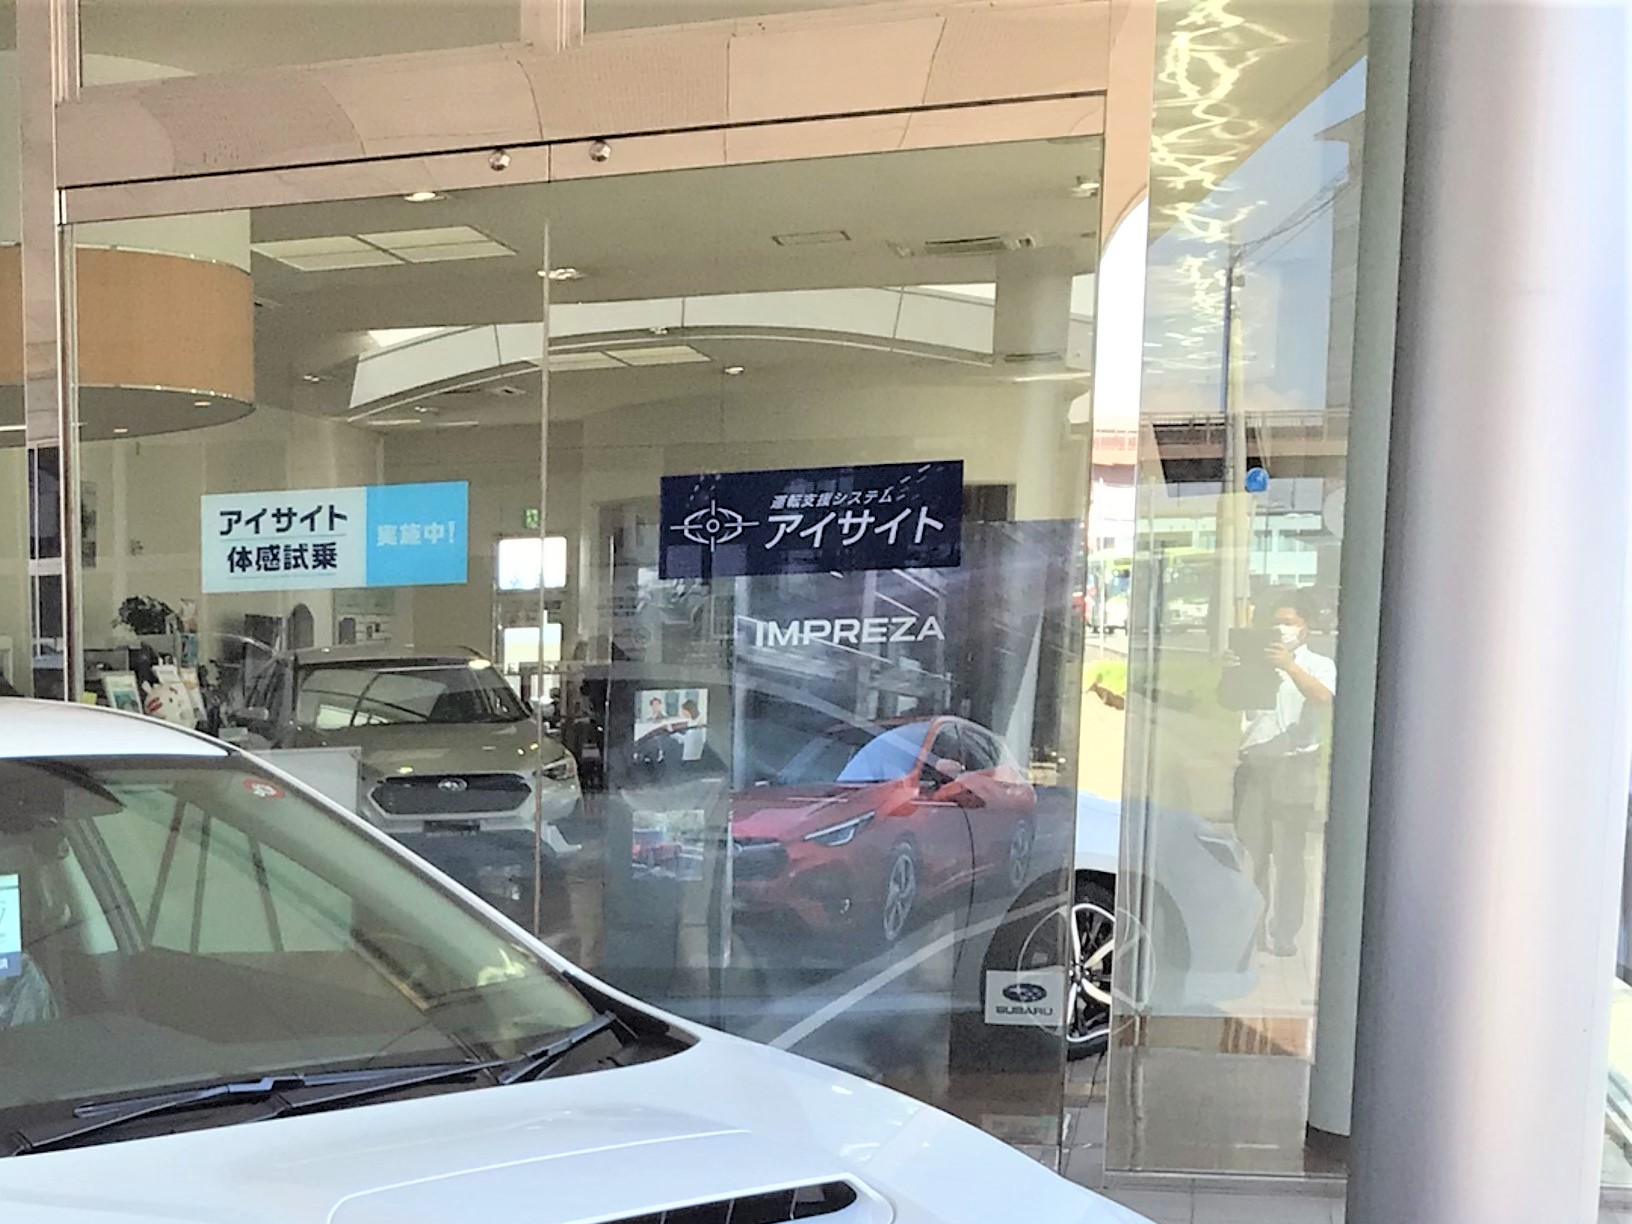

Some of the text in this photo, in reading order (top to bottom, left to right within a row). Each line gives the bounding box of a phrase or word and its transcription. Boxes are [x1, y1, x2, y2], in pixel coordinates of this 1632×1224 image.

[770, 487, 893, 510] 運転支援システム
[219, 504, 348, 536] アイサイト
[765, 506, 945, 550] アイサイト
[227, 542, 338, 574] 体感試乗
[756, 615, 946, 648] IMPREZA
[995, 1005, 1054, 1016] SUBARU
